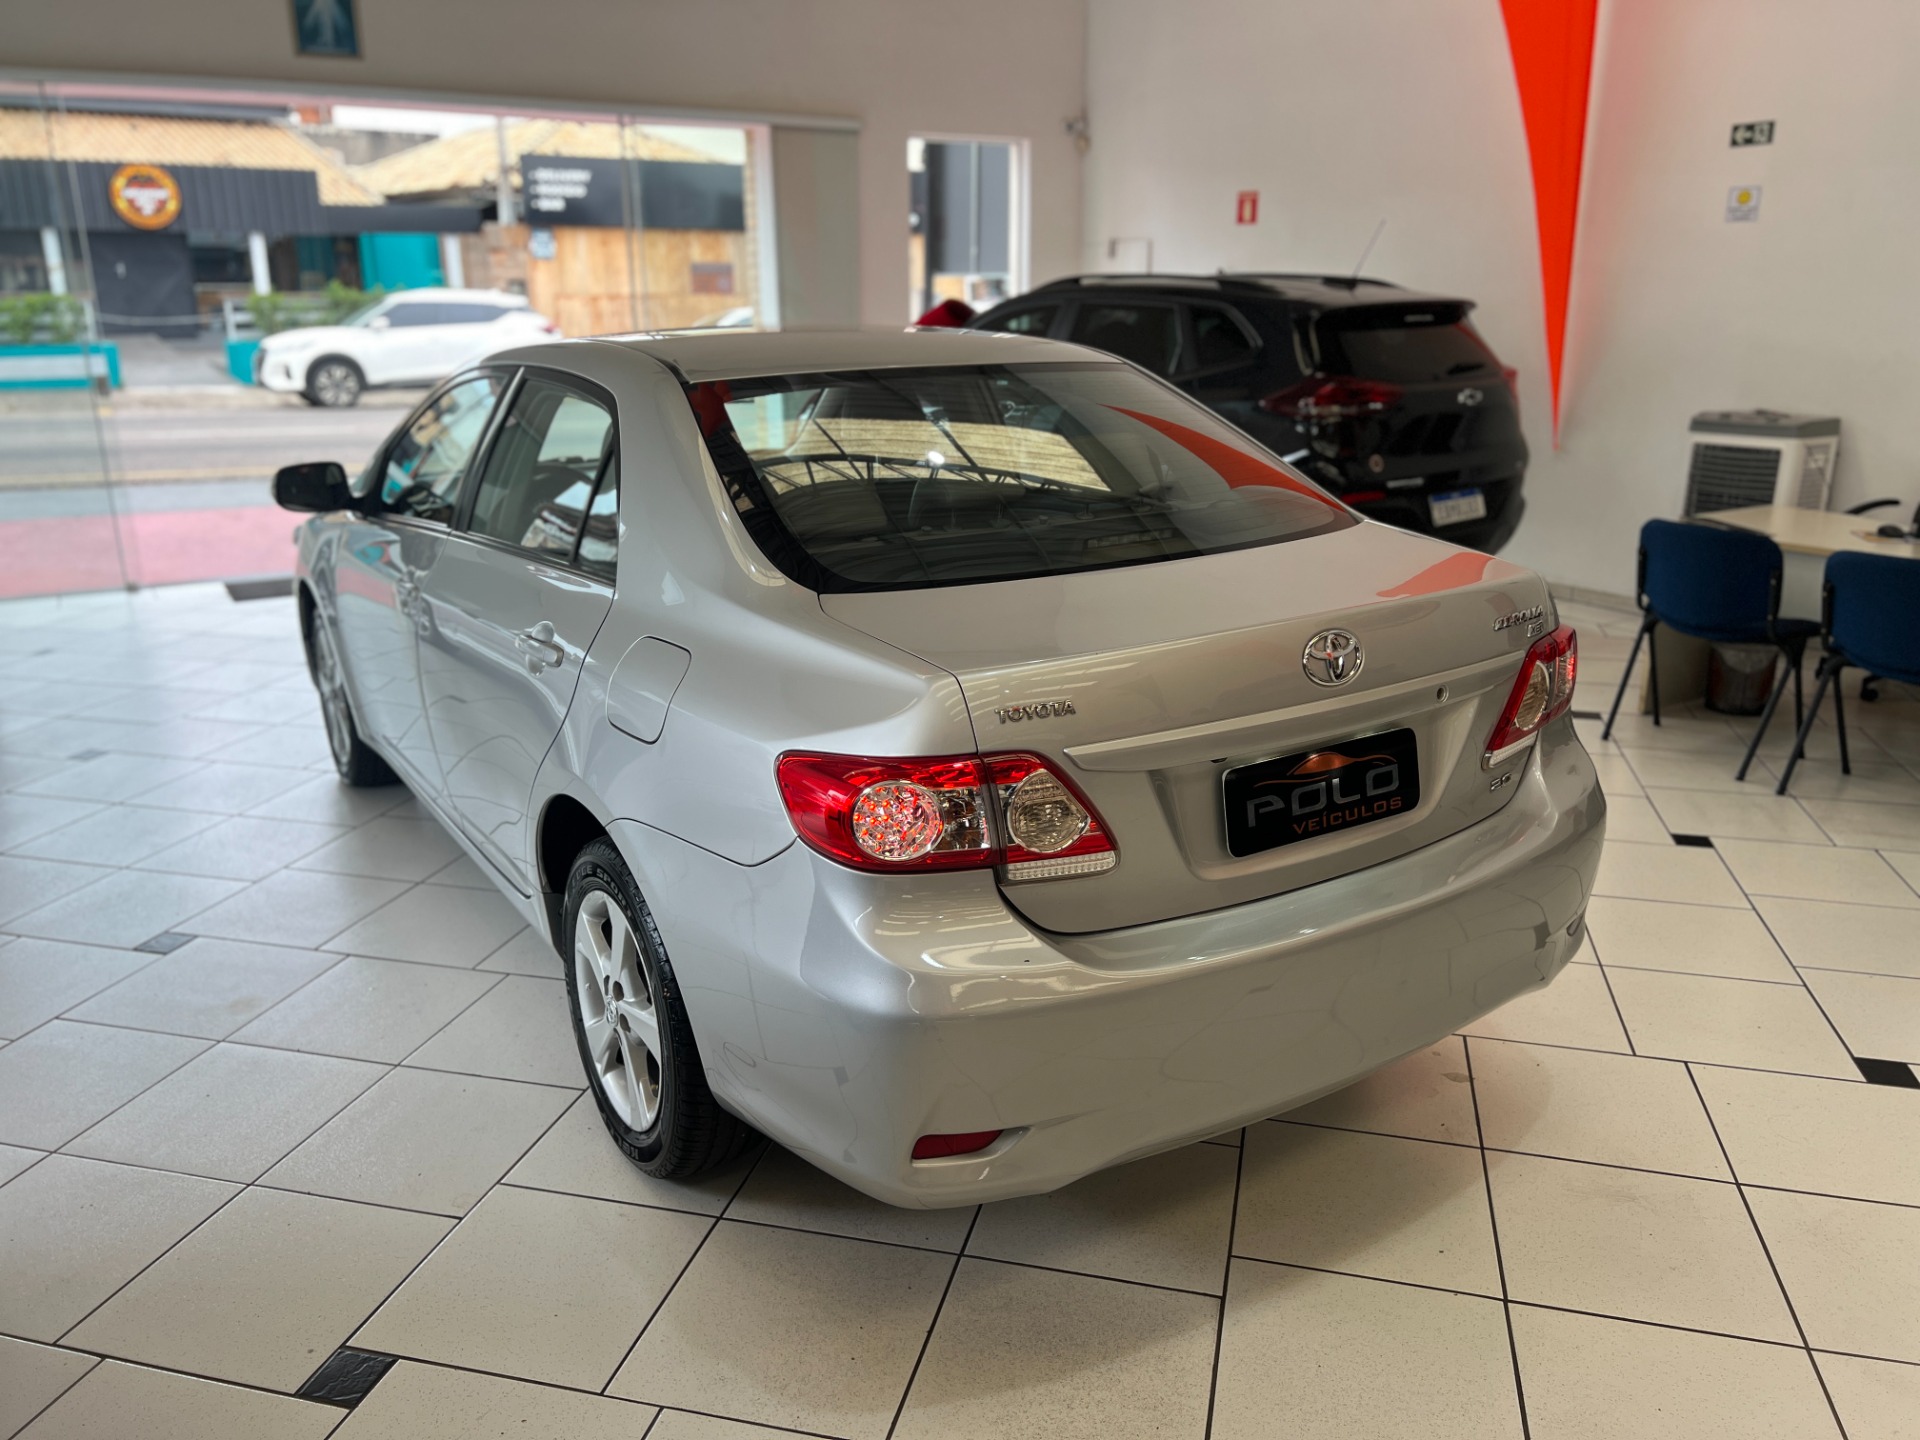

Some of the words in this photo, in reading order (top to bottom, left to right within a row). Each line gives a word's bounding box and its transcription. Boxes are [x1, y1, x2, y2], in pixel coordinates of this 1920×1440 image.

[995, 699, 1076, 724] TOYOTA
[1246, 763, 1400, 828] POLO
[1292, 796, 1402, 834] VEÍCULOS
